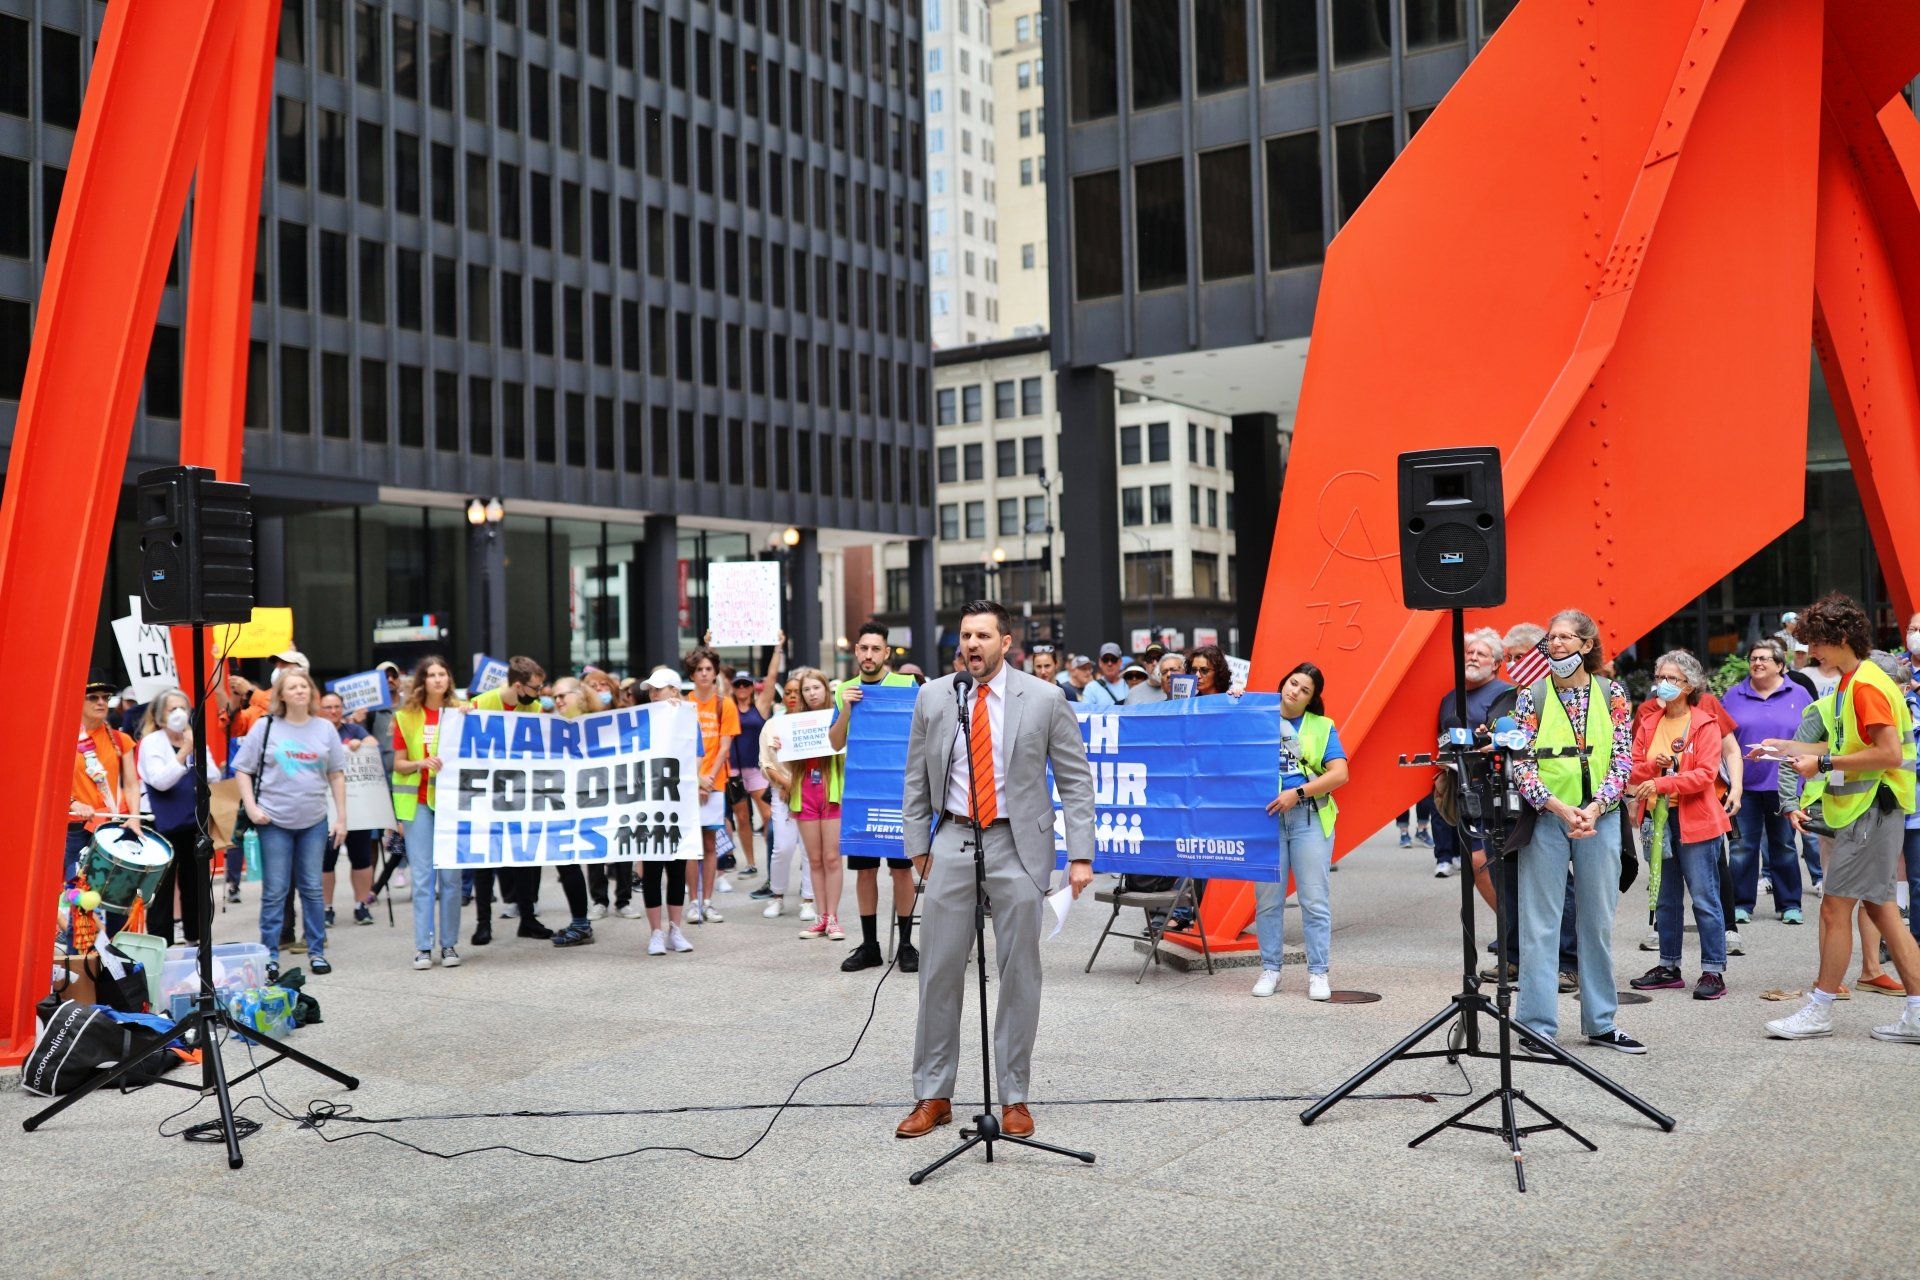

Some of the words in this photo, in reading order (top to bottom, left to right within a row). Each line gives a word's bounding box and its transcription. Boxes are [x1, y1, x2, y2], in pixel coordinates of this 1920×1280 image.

[1306, 600, 1364, 651] 73
[139, 624, 168, 654] MY
[339, 680, 370, 692] MARCH
[358, 687, 377, 697] OUR
[458, 708, 651, 760] MARCH
[793, 732, 826, 742] DEMAND
[794, 740, 822, 749] ACTION
[1455, 727, 1467, 745] 9
[458, 768, 566, 812] FOR
[576, 757, 681, 809] OUR
[456, 815, 609, 864] LIVES
[1175, 837, 1245, 856] GIFFORDS
[33, 1007, 82, 1090] cocoononline.com
